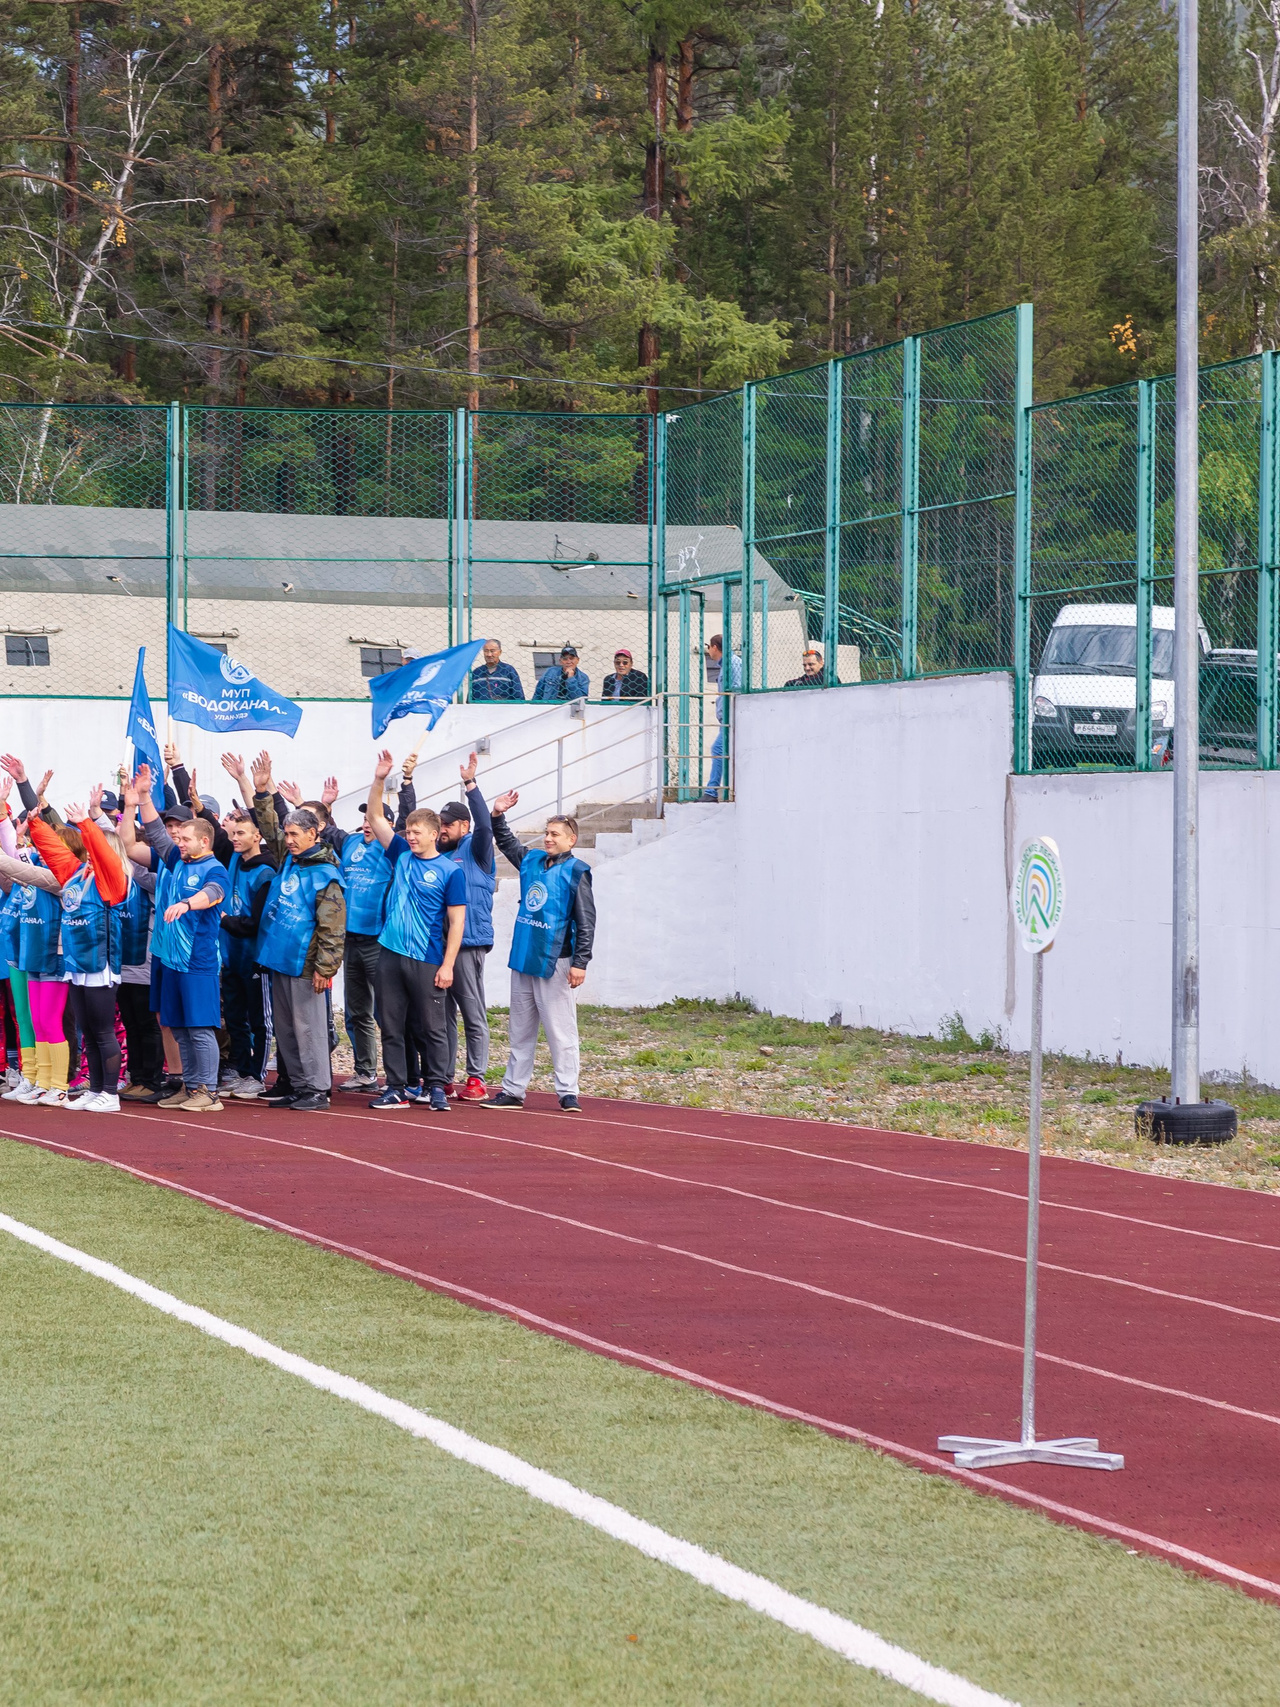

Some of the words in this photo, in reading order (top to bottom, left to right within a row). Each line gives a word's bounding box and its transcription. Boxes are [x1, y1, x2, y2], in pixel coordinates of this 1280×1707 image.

[221, 688, 251, 698] МУП
[182, 690, 288, 715] «ВОДОКАНАЛ»
[214, 712, 249, 720] УЛАН-УДЭ
[137, 717, 157, 741] «ВО
